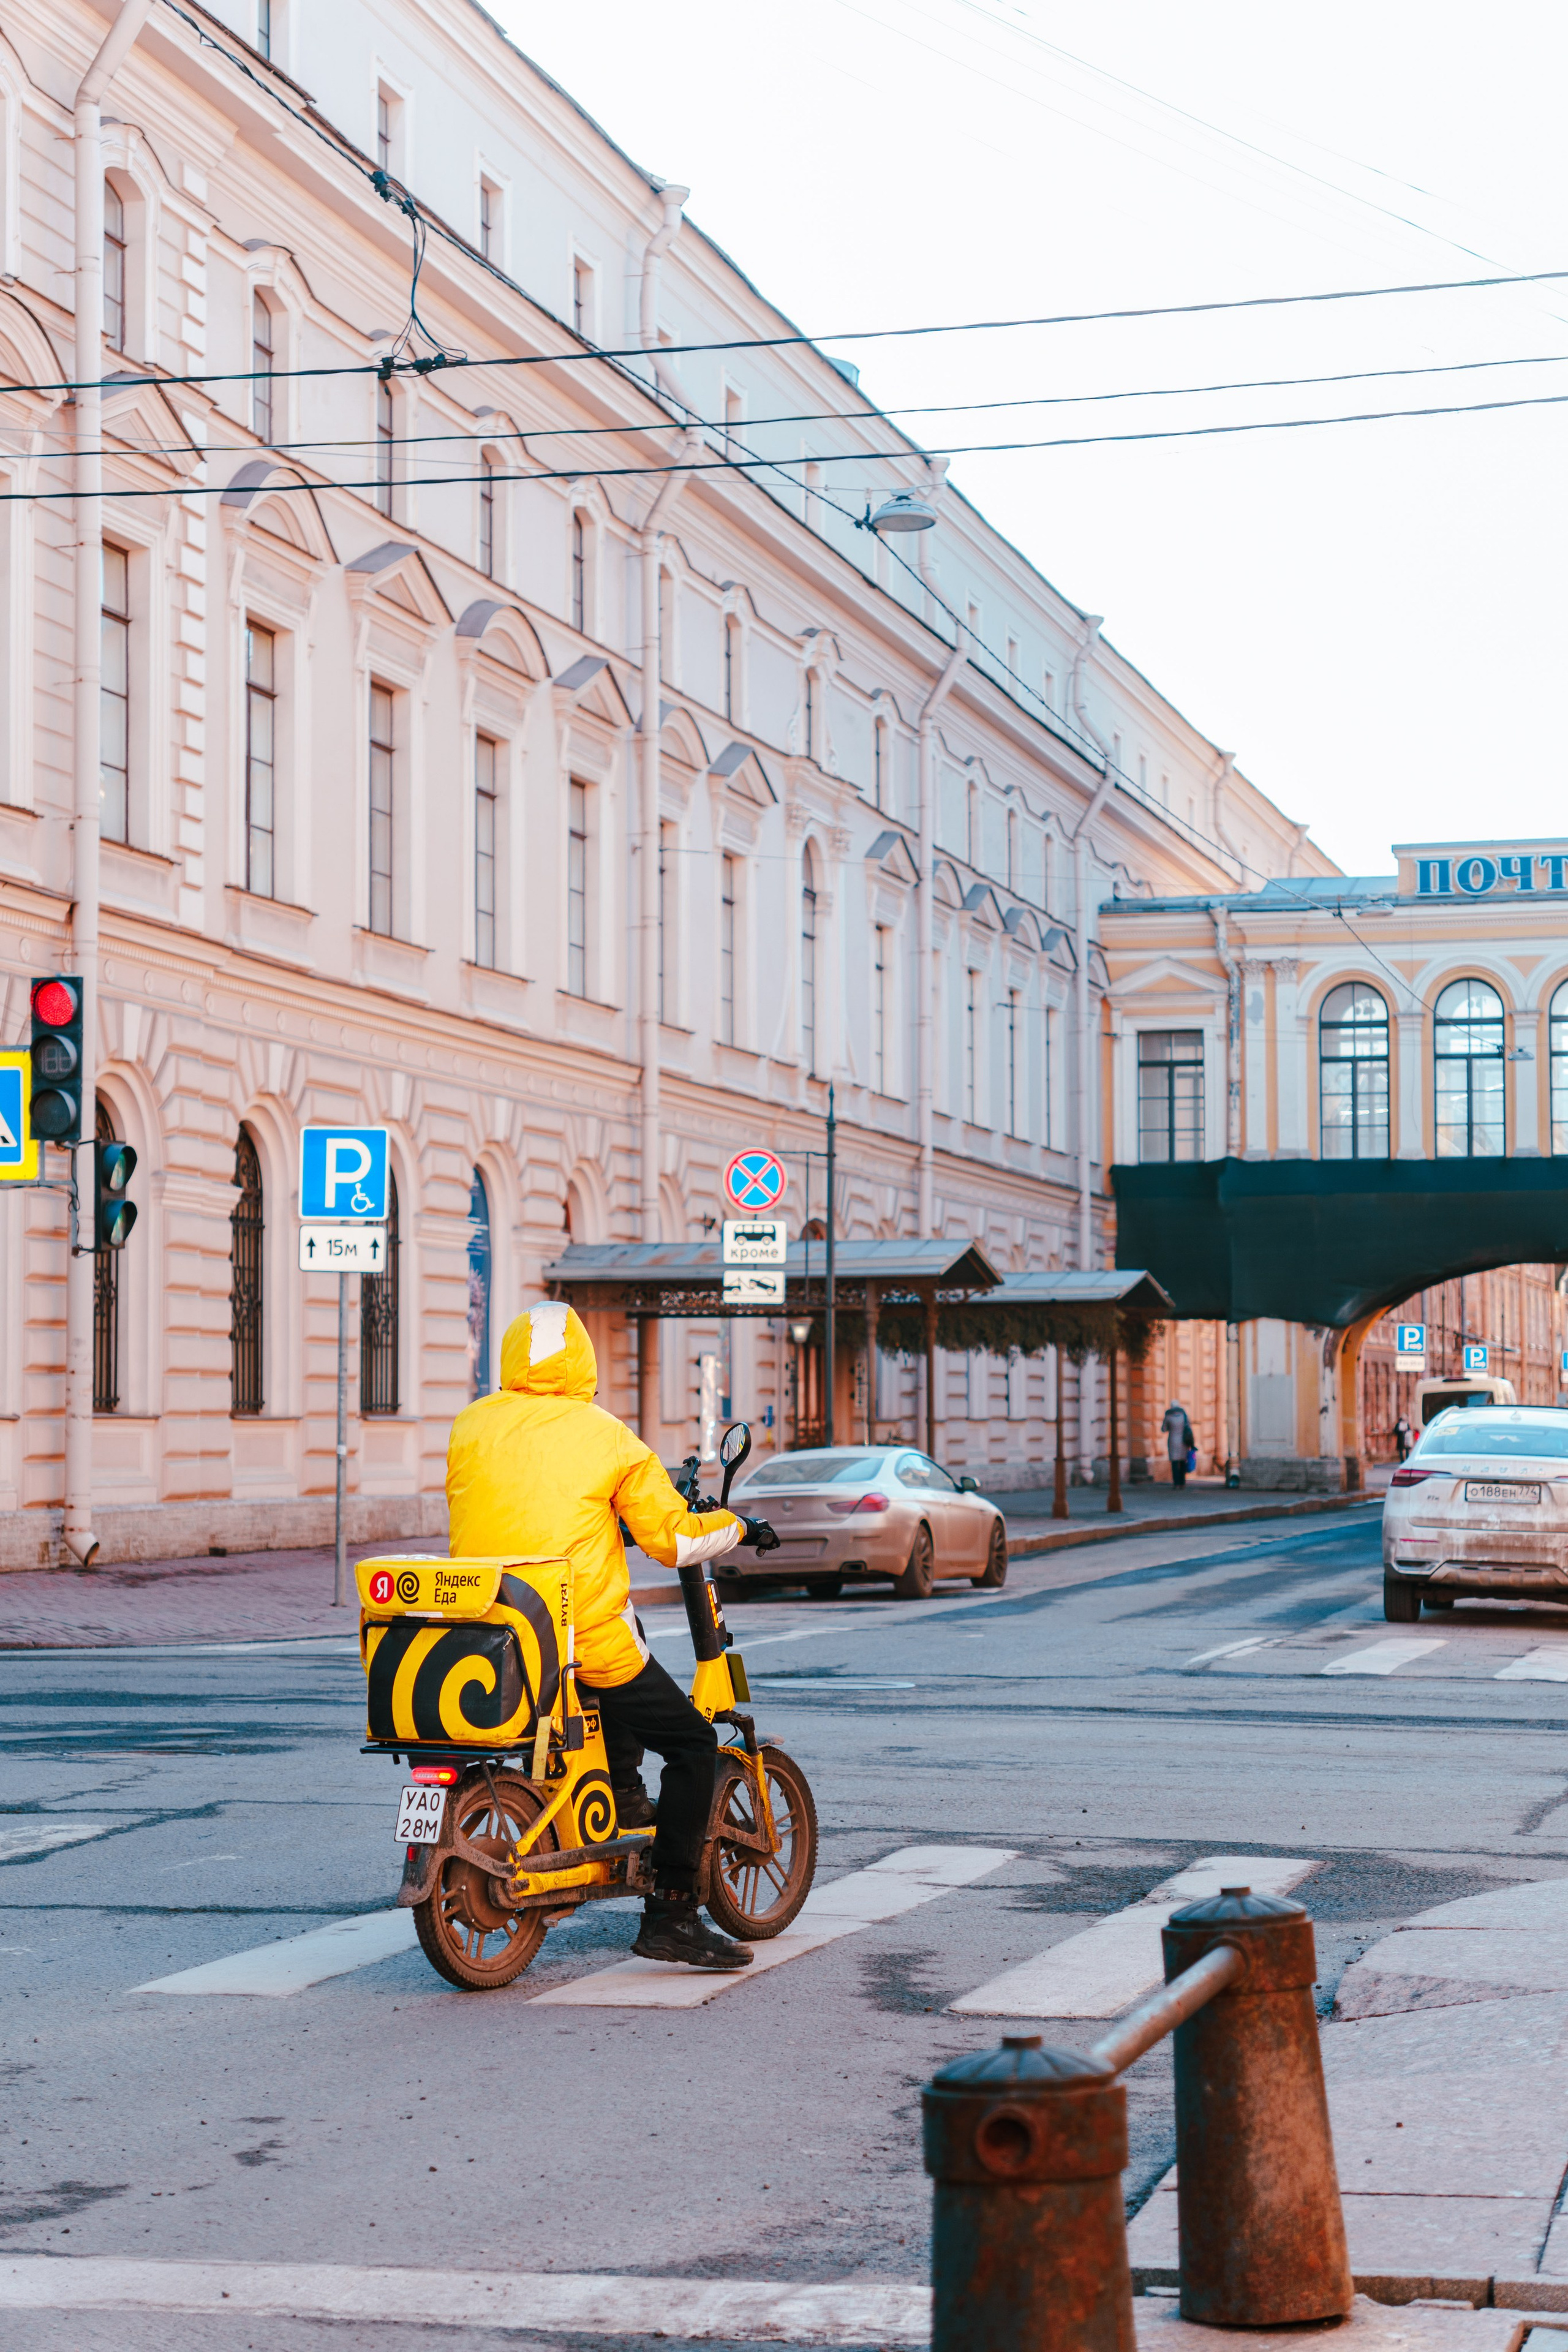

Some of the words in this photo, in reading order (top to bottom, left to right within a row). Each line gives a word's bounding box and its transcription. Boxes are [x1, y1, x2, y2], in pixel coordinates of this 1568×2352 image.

[325, 1138, 372, 1208] P
[327, 1239, 357, 1256] 15м
[731, 1248, 778, 1261] кроме
[435, 1572, 481, 1588] Яндекс
[434, 1588, 456, 1605] Еда
